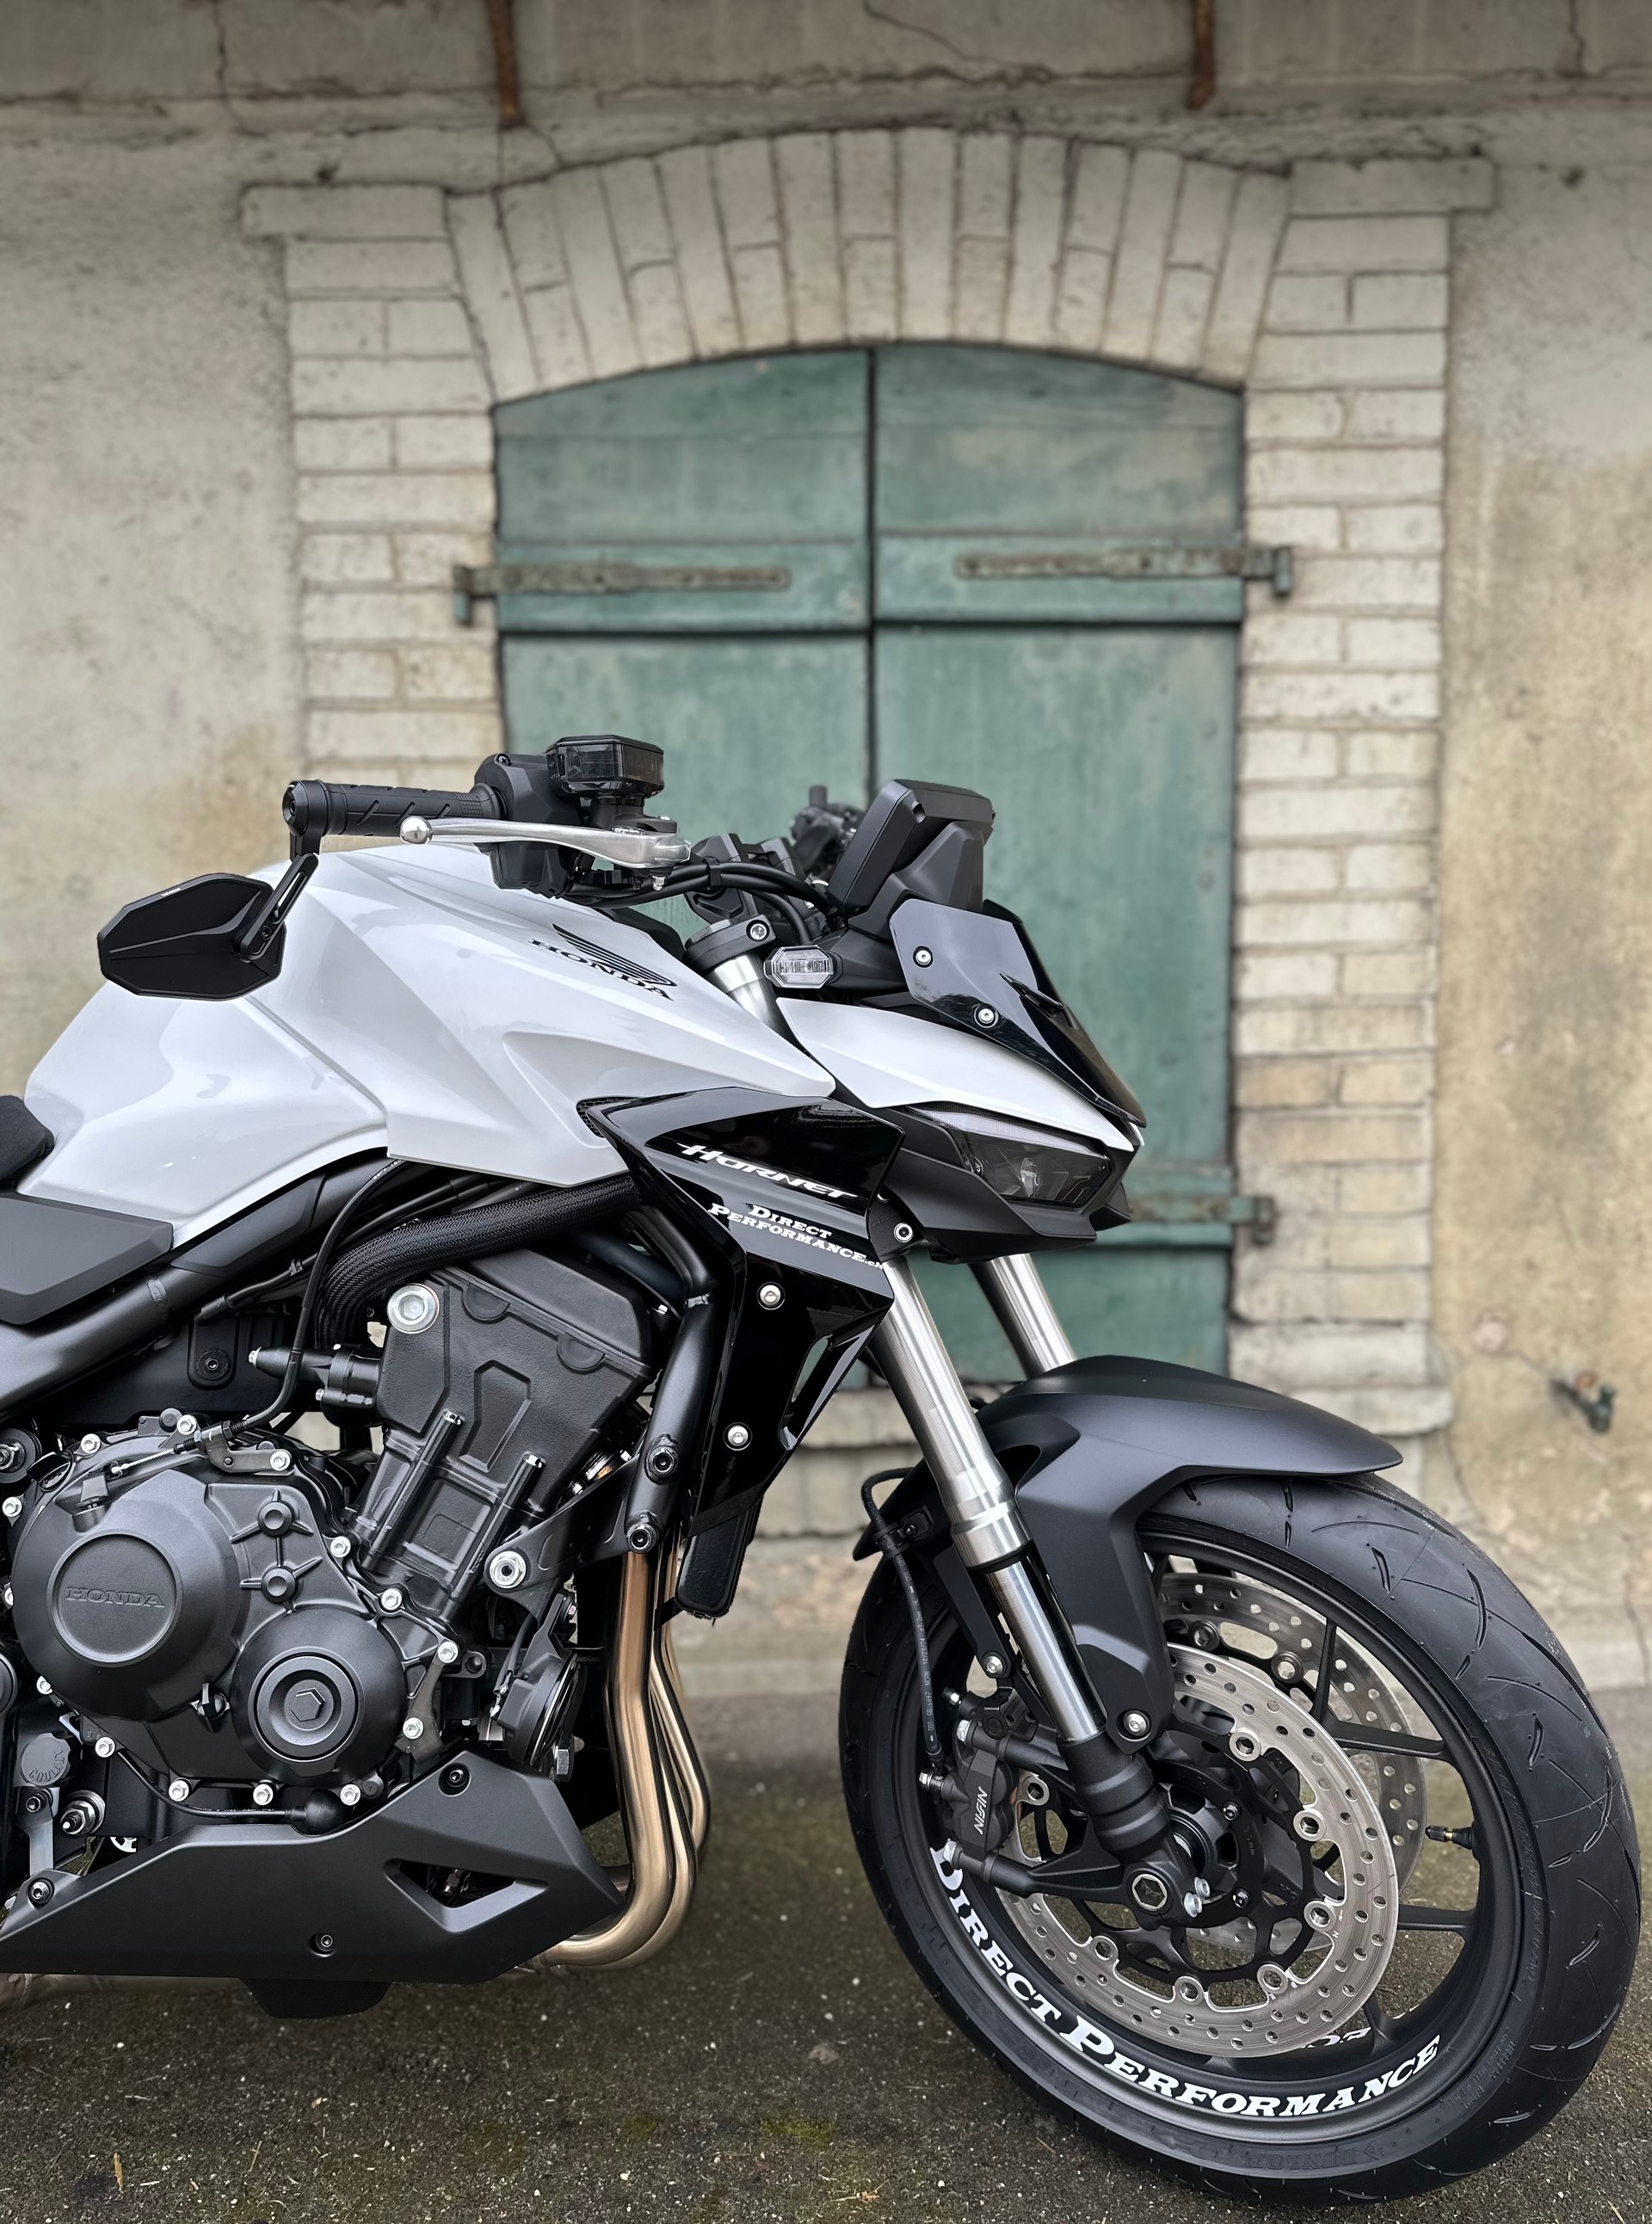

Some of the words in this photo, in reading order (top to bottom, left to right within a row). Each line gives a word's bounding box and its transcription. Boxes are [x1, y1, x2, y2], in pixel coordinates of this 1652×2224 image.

[527, 938, 674, 1001] HONDA
[676, 1143, 859, 1198] HORNET
[748, 1204, 833, 1239] DIRECT
[65, 1586, 165, 1608] HONDA
[930, 1847, 1062, 2023] DIRECT
[1059, 2014, 1441, 2117] PERFORMANCE
[1244, 2146, 1359, 2171] DUNLOP
